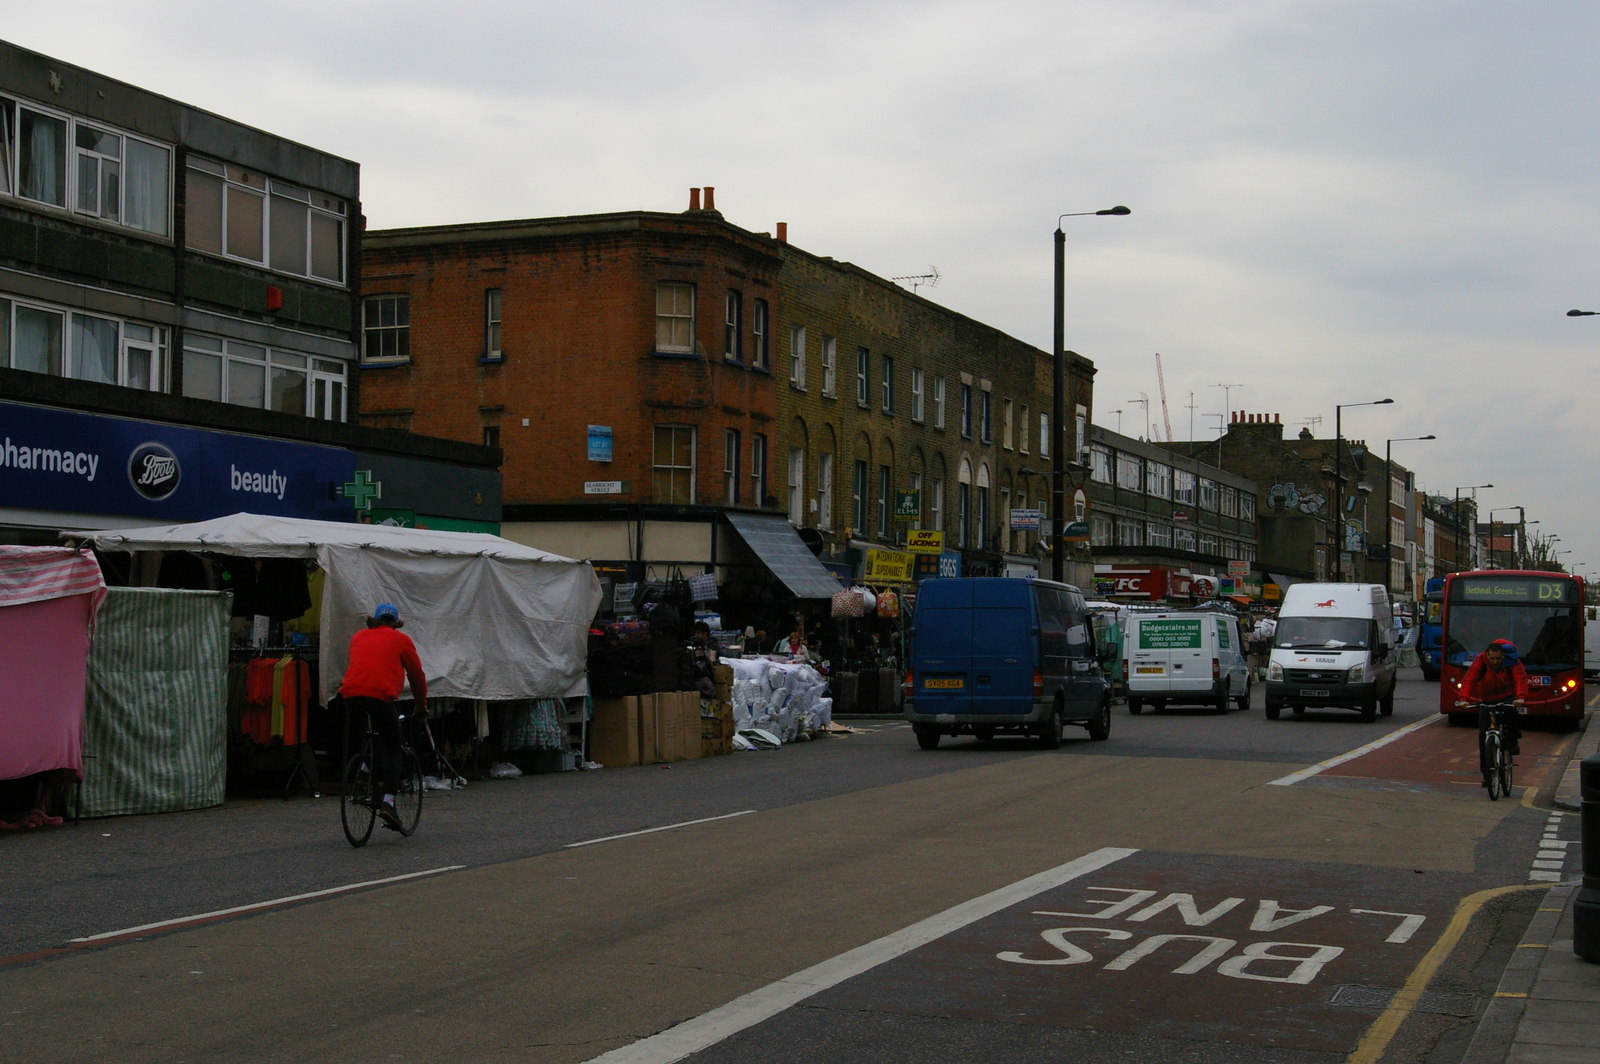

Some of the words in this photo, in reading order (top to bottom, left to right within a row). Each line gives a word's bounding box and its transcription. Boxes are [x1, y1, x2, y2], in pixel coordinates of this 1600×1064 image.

[138, 454, 176, 486] Boots
[230, 464, 287, 500] beauty
[909, 539, 940, 547] LICENCE
[940, 558, 957, 578] EGGS
[1113, 578, 1142, 591] FC
[1465, 586, 1491, 595] Bethnal
[1494, 586, 1513, 595] Green
[1538, 583, 1562, 600] D3
[1032, 886, 1426, 943] LANE
[996, 926, 1345, 984] BUS
